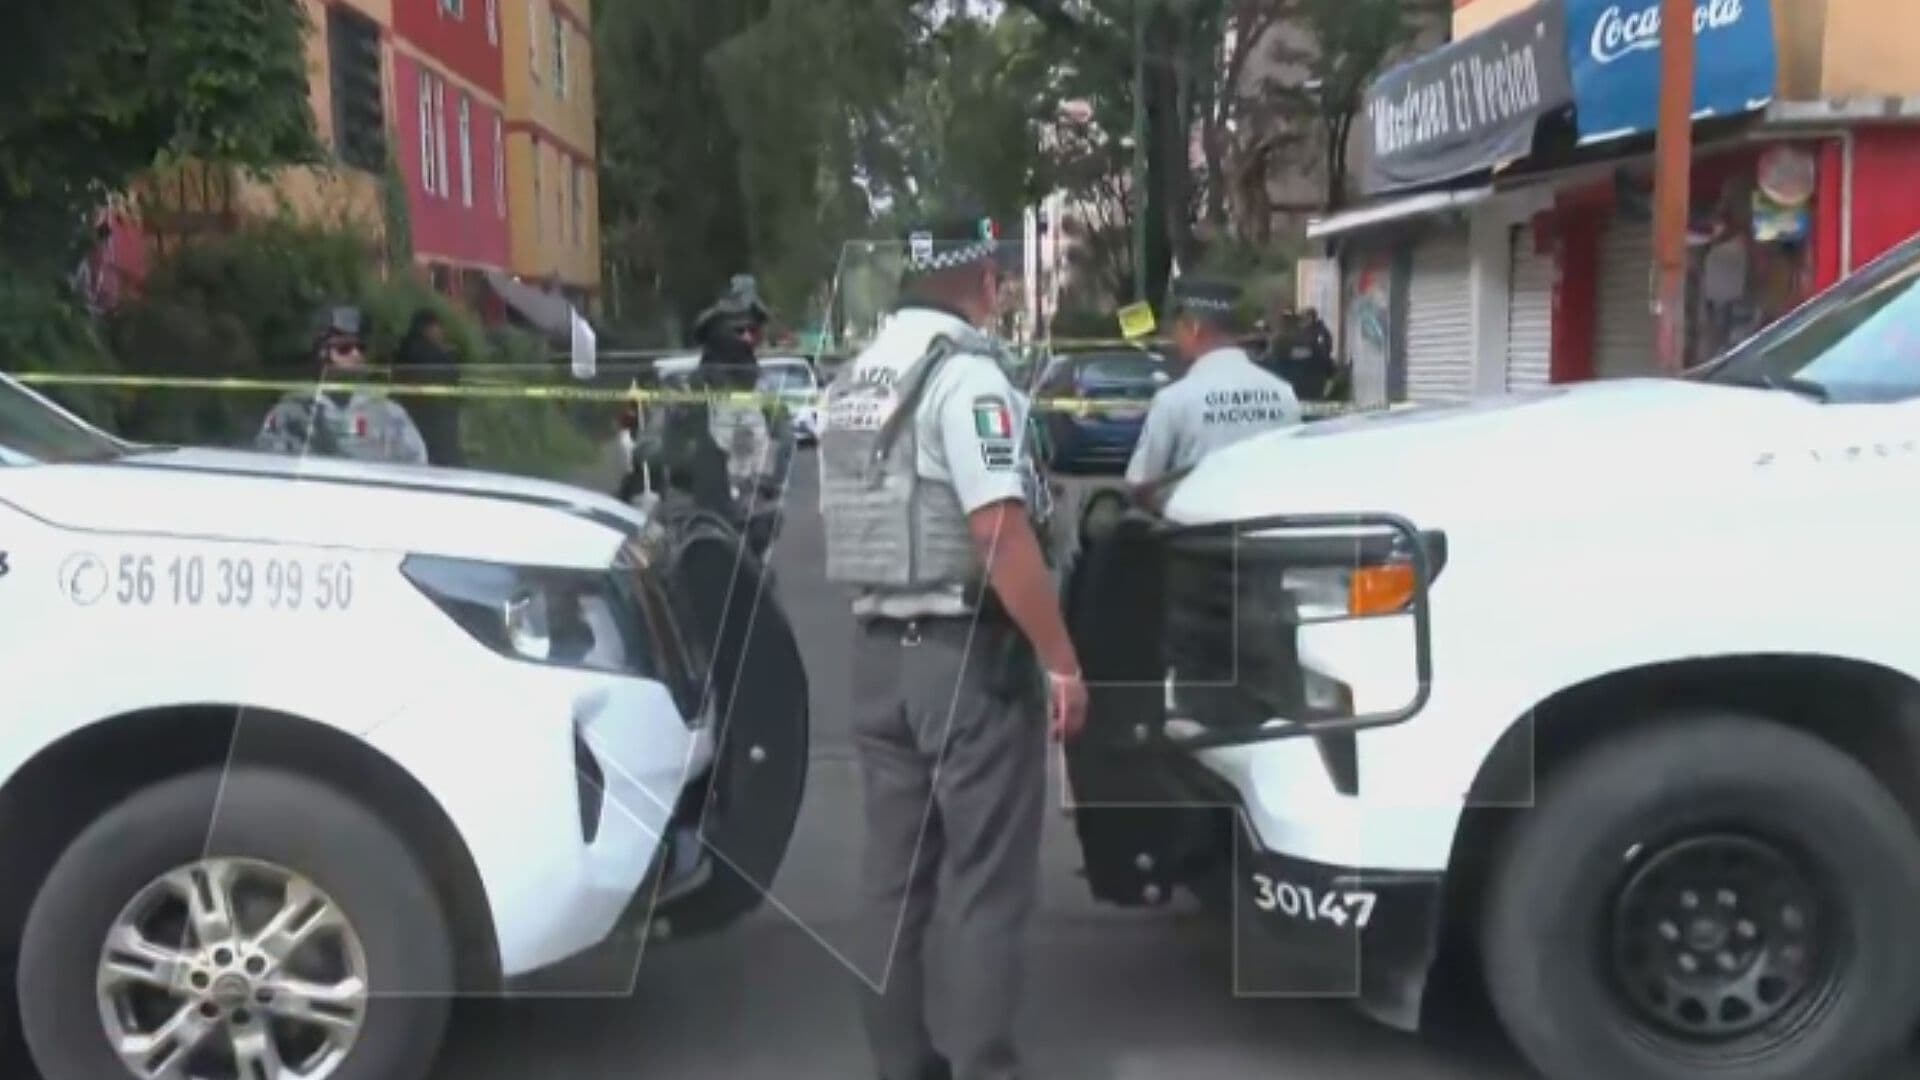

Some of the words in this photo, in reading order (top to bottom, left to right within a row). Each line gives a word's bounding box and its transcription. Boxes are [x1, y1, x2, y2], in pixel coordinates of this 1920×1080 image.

[1205, 390, 1281, 405] GUARDIA
[117, 553, 155, 605] 56
[168, 555, 204, 606] 10
[216, 556, 254, 607] 39
[266, 558, 303, 610] 99
[315, 561, 354, 610] 50
[1252, 872, 1377, 928] 30147
